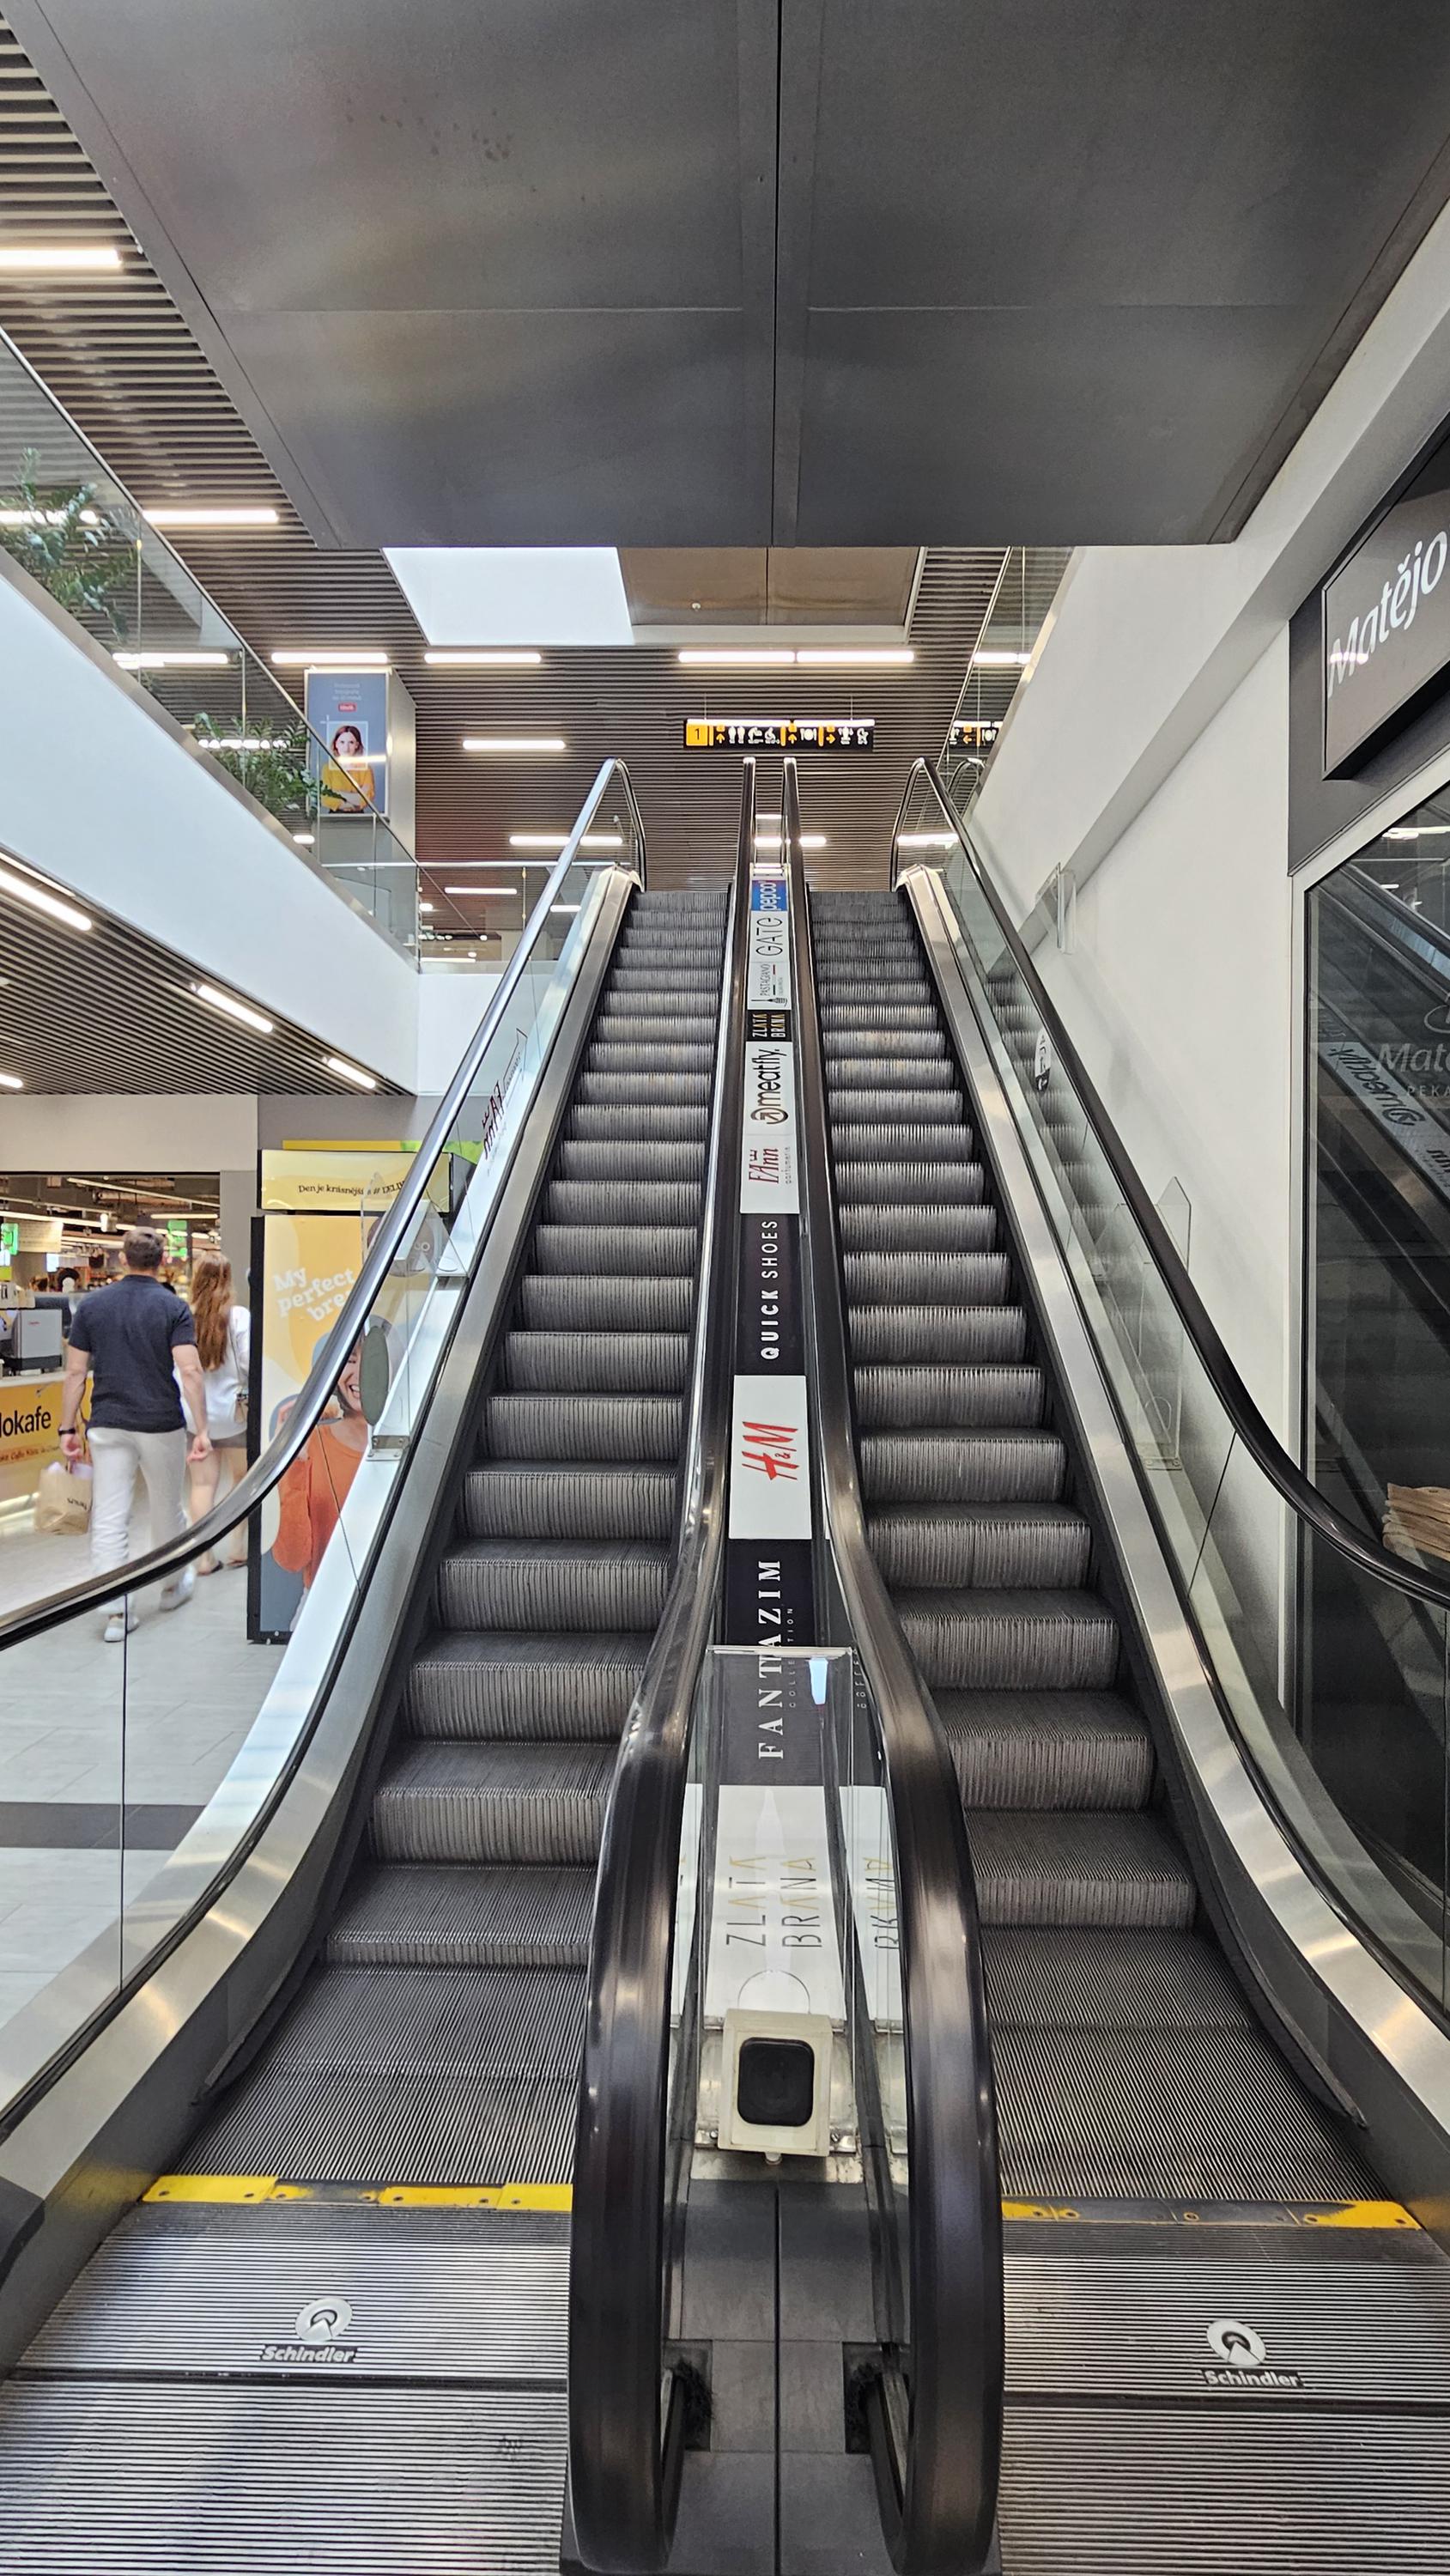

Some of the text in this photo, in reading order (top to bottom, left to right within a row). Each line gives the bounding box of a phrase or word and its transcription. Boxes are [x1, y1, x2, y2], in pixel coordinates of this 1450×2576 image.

[760, 883, 781, 911] pepco
[273, 1267, 306, 1291] My
[277, 1268, 356, 1318] perfect
[761, 1220, 780, 1360] QUICK SHOES
[742, 1421, 799, 1480] H&M
[787, 1607, 797, 1709] COLLETION
[261, 2346, 355, 2363] Schindler
[1204, 2370, 1300, 2387] Schindler
